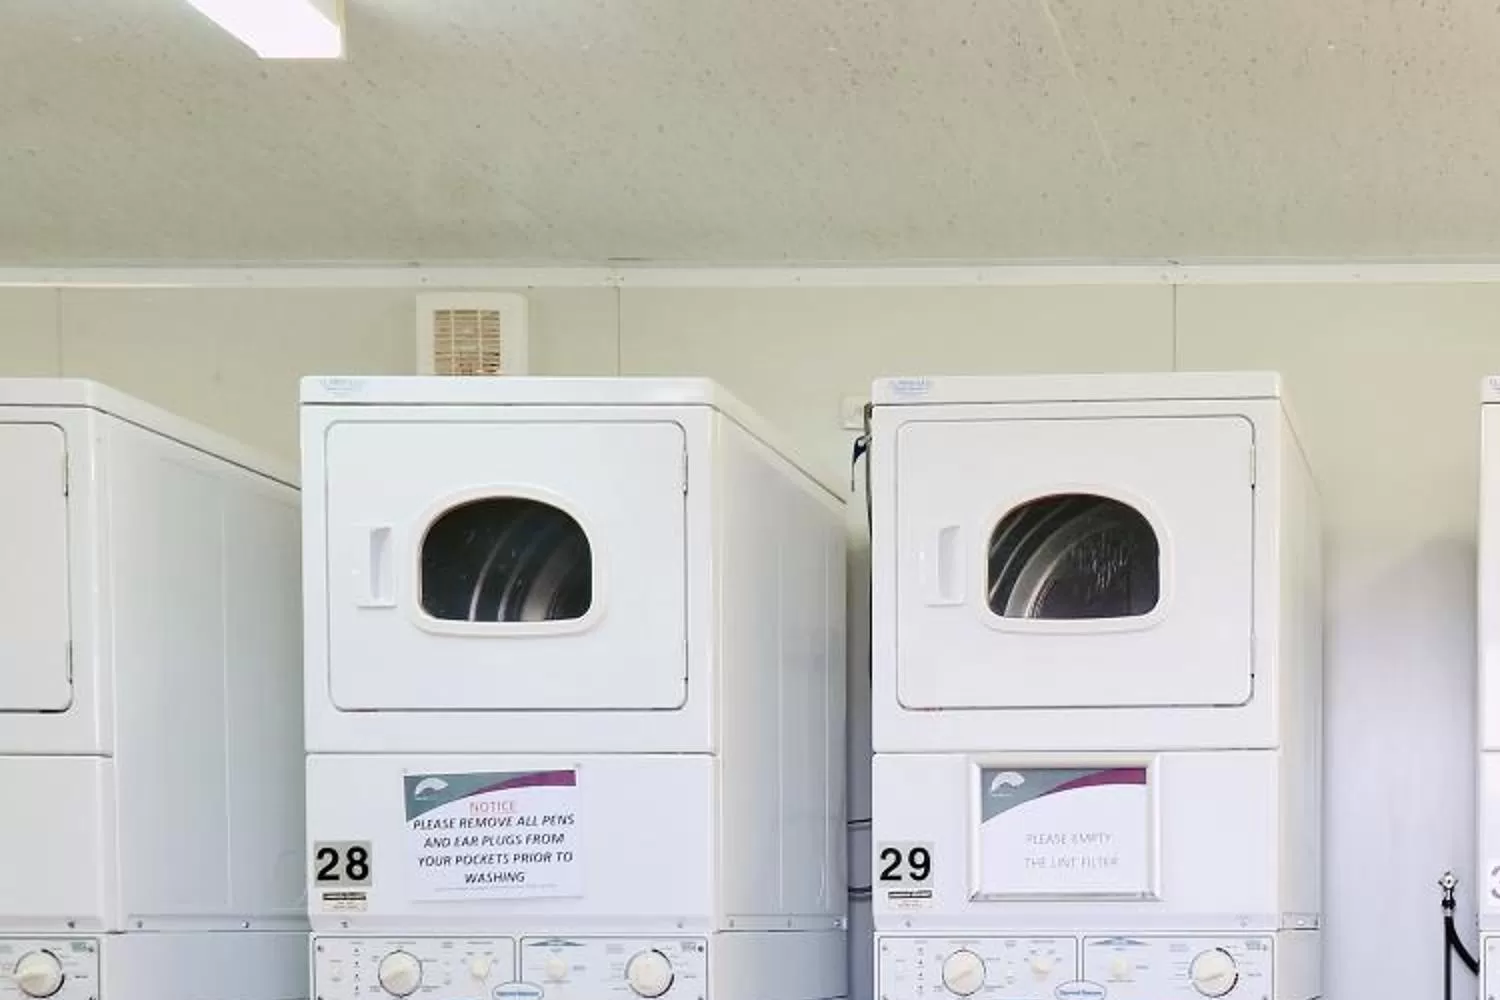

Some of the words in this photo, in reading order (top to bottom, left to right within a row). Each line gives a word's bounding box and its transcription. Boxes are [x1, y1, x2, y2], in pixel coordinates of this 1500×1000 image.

[469, 801, 515, 813] NOTICE
[413, 817, 455, 830] PLEASE
[460, 816, 513, 829] REMOVE
[517, 815, 538, 828] ALL
[541, 813, 575, 827] PENS
[424, 837, 450, 848] AND
[453, 836, 478, 847] EAR
[481, 835, 522, 847] PLUGS
[525, 833, 565, 845] FROM
[317, 846, 368, 880] 28
[418, 855, 450, 867] YOUR
[455, 853, 509, 865] POCKETS
[513, 852, 552, 864] PRIOR
[555, 851, 573, 863] TO
[880, 847, 931, 881] 29
[464, 871, 525, 884] WASHING
